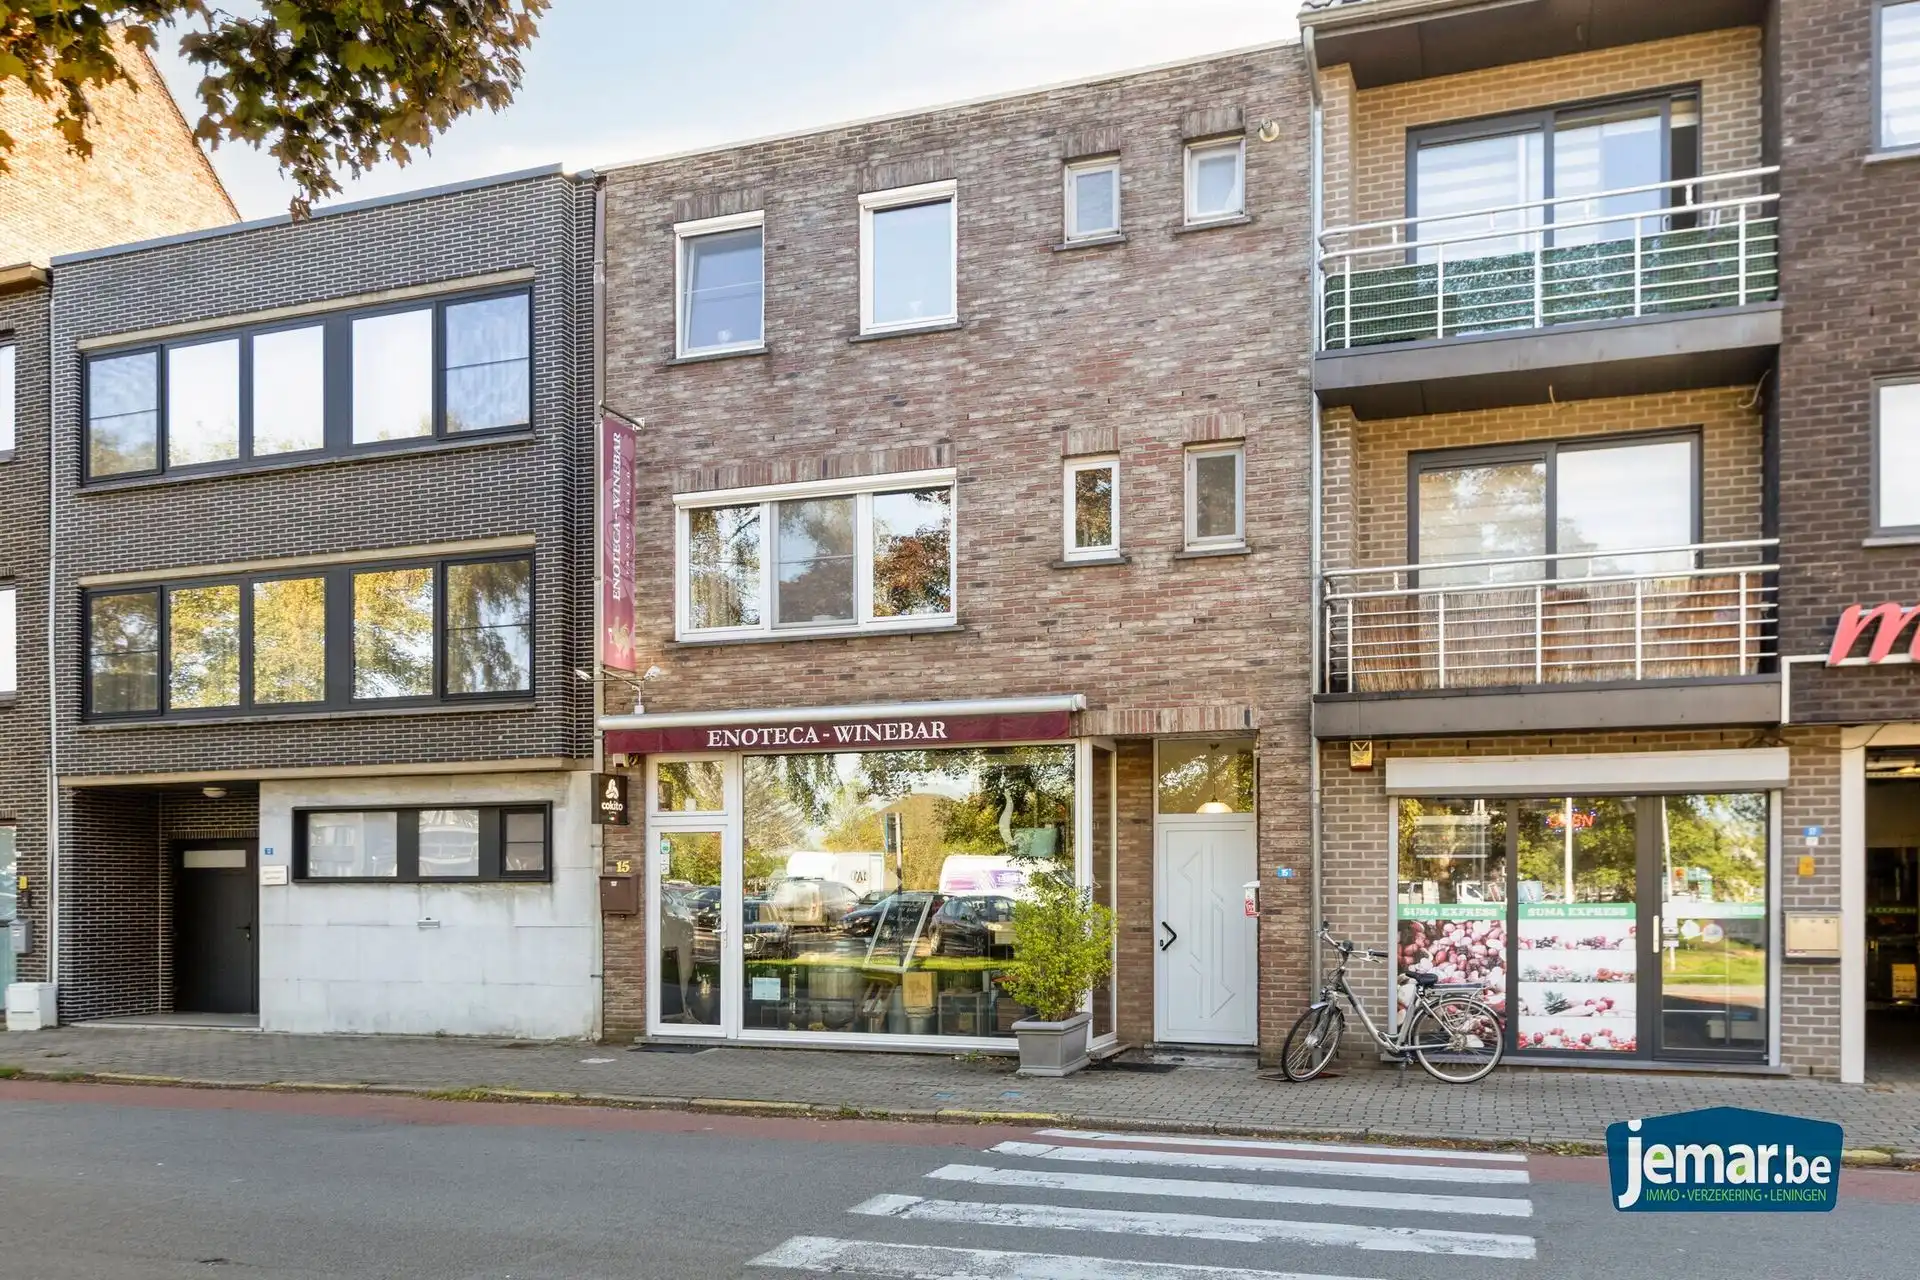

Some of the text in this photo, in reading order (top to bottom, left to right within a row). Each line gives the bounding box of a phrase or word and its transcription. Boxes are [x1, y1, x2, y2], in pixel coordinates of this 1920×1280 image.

[612, 432, 622, 510] WINEBAR
[612, 521, 622, 601] ENOTECA
[707, 726, 820, 748] ENOTECA
[833, 720, 947, 743] WINEBAR
[601, 801, 624, 811] cokito
[615, 860, 631, 872] 15
[1402, 907, 1497, 917] SUMA EXPRESS
[1527, 907, 1628, 917] SUMA EXPRESS
